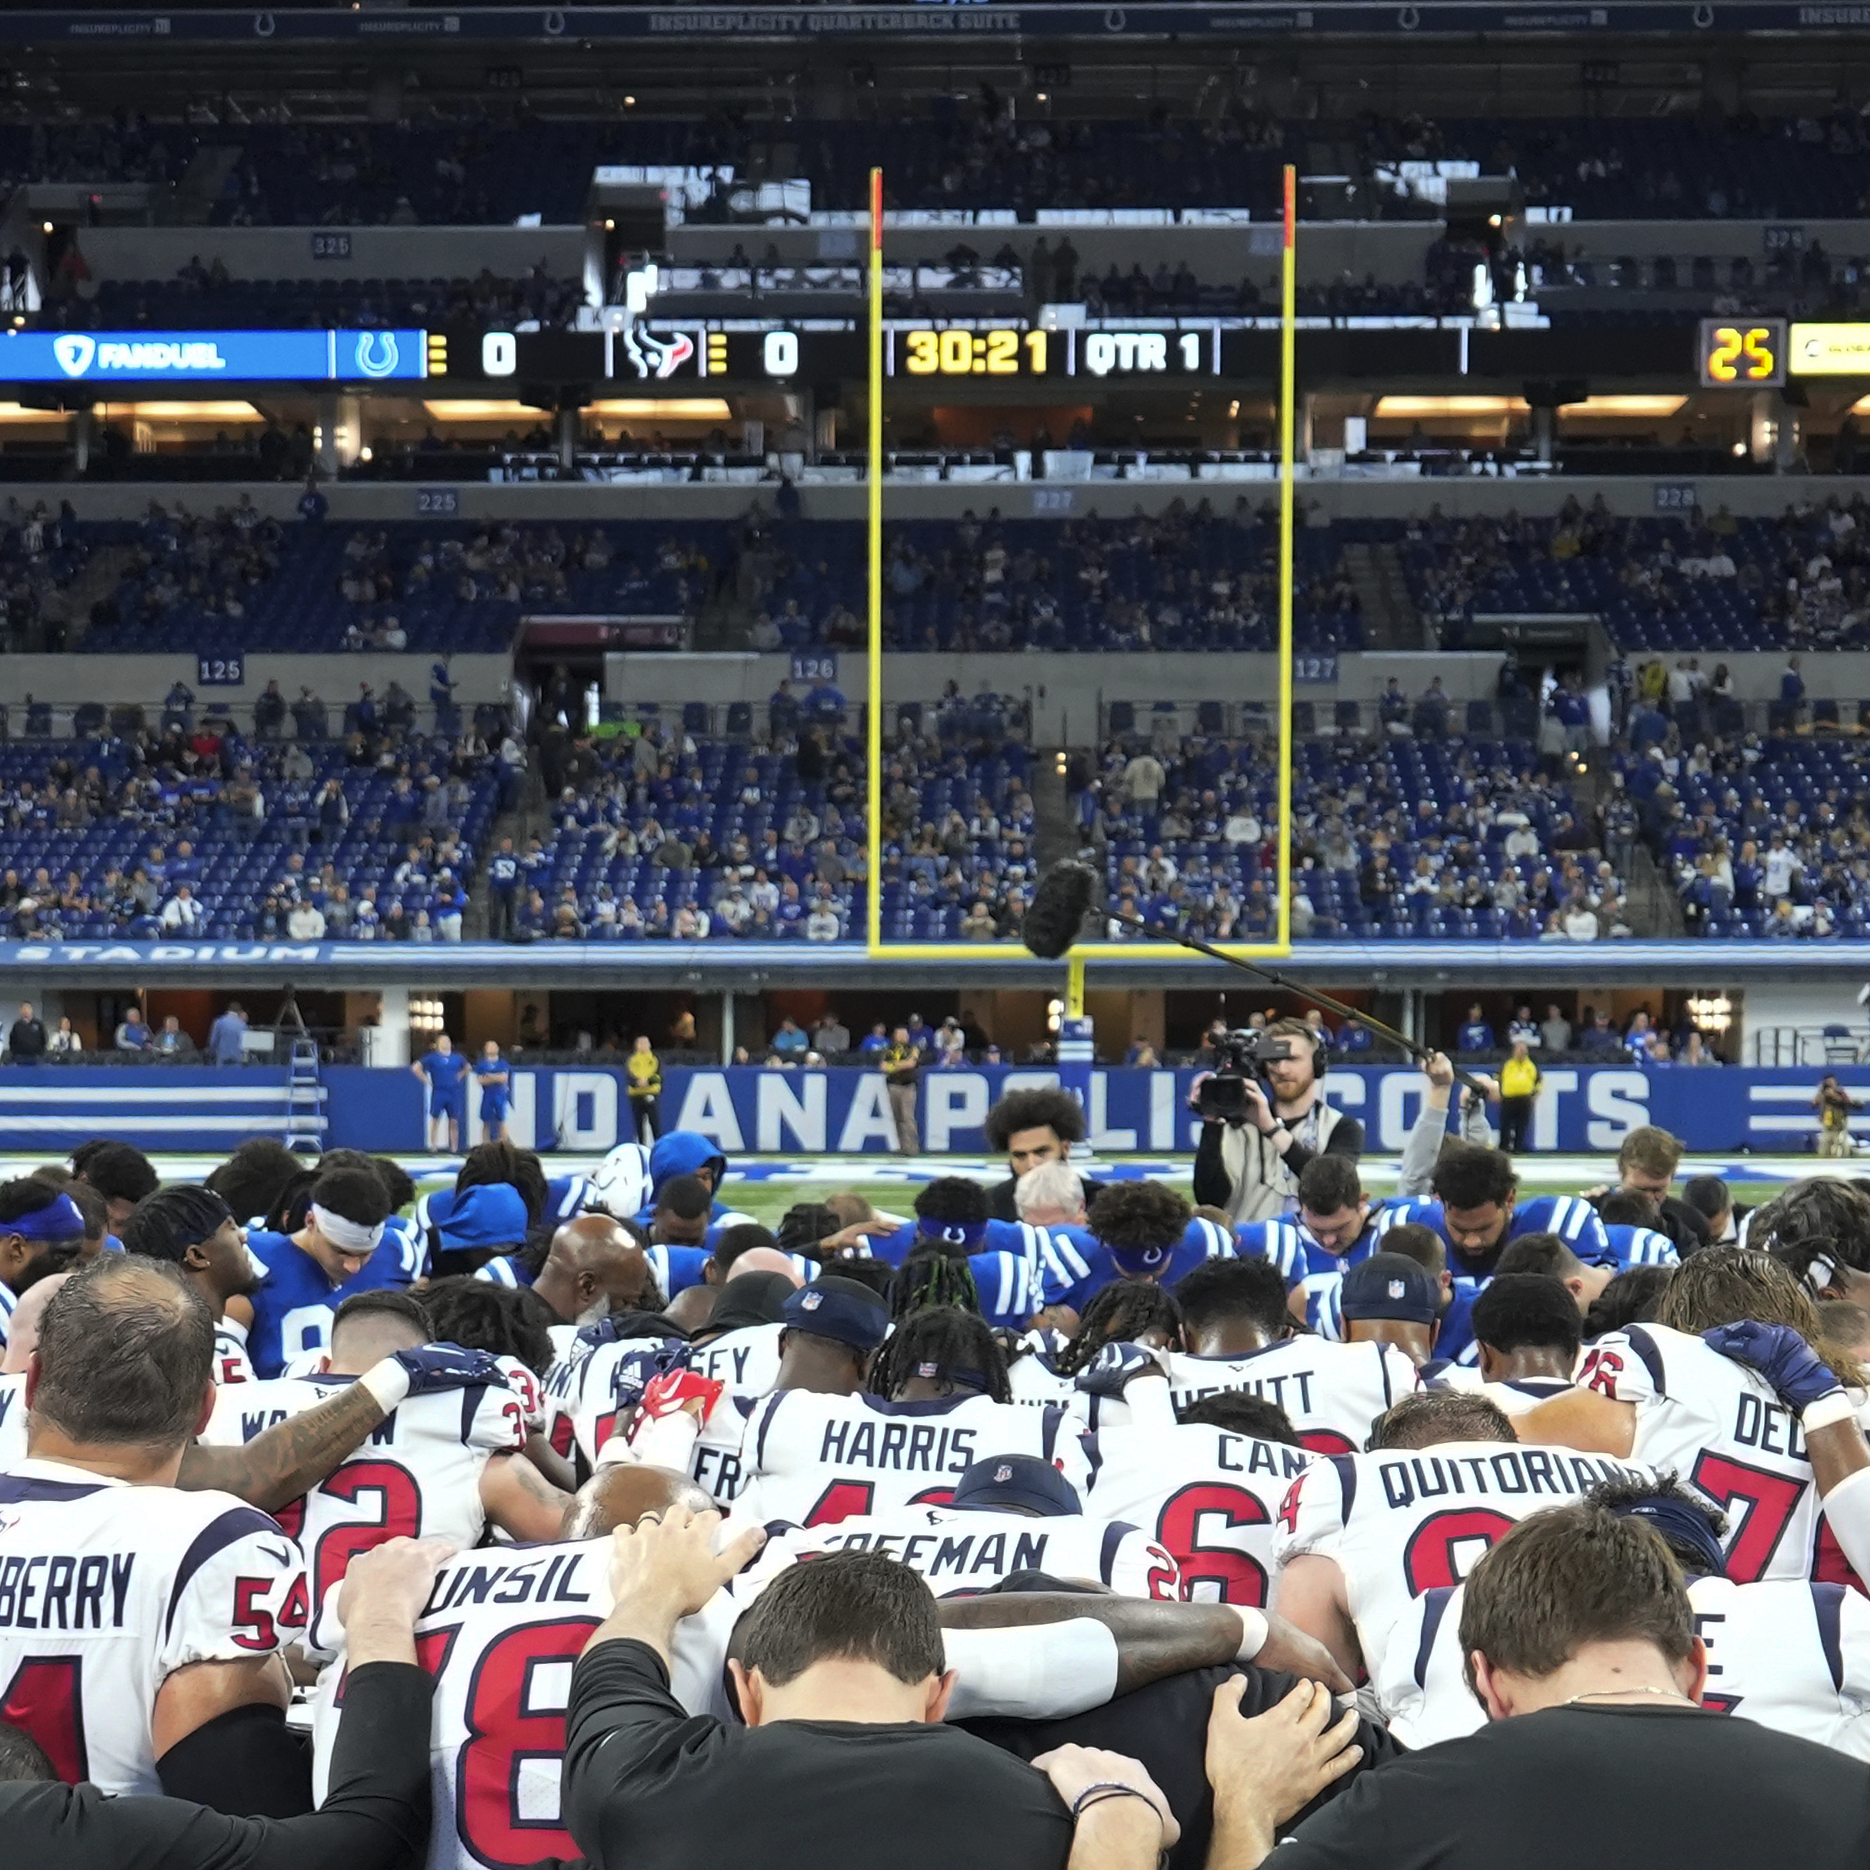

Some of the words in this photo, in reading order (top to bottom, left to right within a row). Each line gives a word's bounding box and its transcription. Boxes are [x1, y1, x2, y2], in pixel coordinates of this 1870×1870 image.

[805, 13, 954, 31] QUARTERBACK
[959, 13, 1020, 30] SUITE
[98, 343, 226, 370] FANDUEL
[482, 331, 517, 377] 0
[763, 331, 798, 377] 0
[905, 330, 1048, 376] 30:21
[1085, 333, 1167, 376] QTR
[1179, 333, 1200, 371] 1
[1708, 328, 1774, 381] 25
[419, 495, 457, 511] 225
[200, 660, 241, 679] 125
[794, 660, 834, 679] 126
[1294, 660, 1336, 679] 127
[13, 945, 320, 961] STADIUM
[1325, 1071, 1652, 1151] COTS
[1170, 1370, 1314, 1424] HITT
[819, 1418, 978, 1474] HARRIS
[1218, 1433, 1309, 1480] CAN
[1379, 1450, 1656, 1509] QUITORIAN
[823, 1531, 1050, 1577] REMAN
[419, 1552, 597, 1621] UNSIL
[230, 1571, 309, 1651] 54
